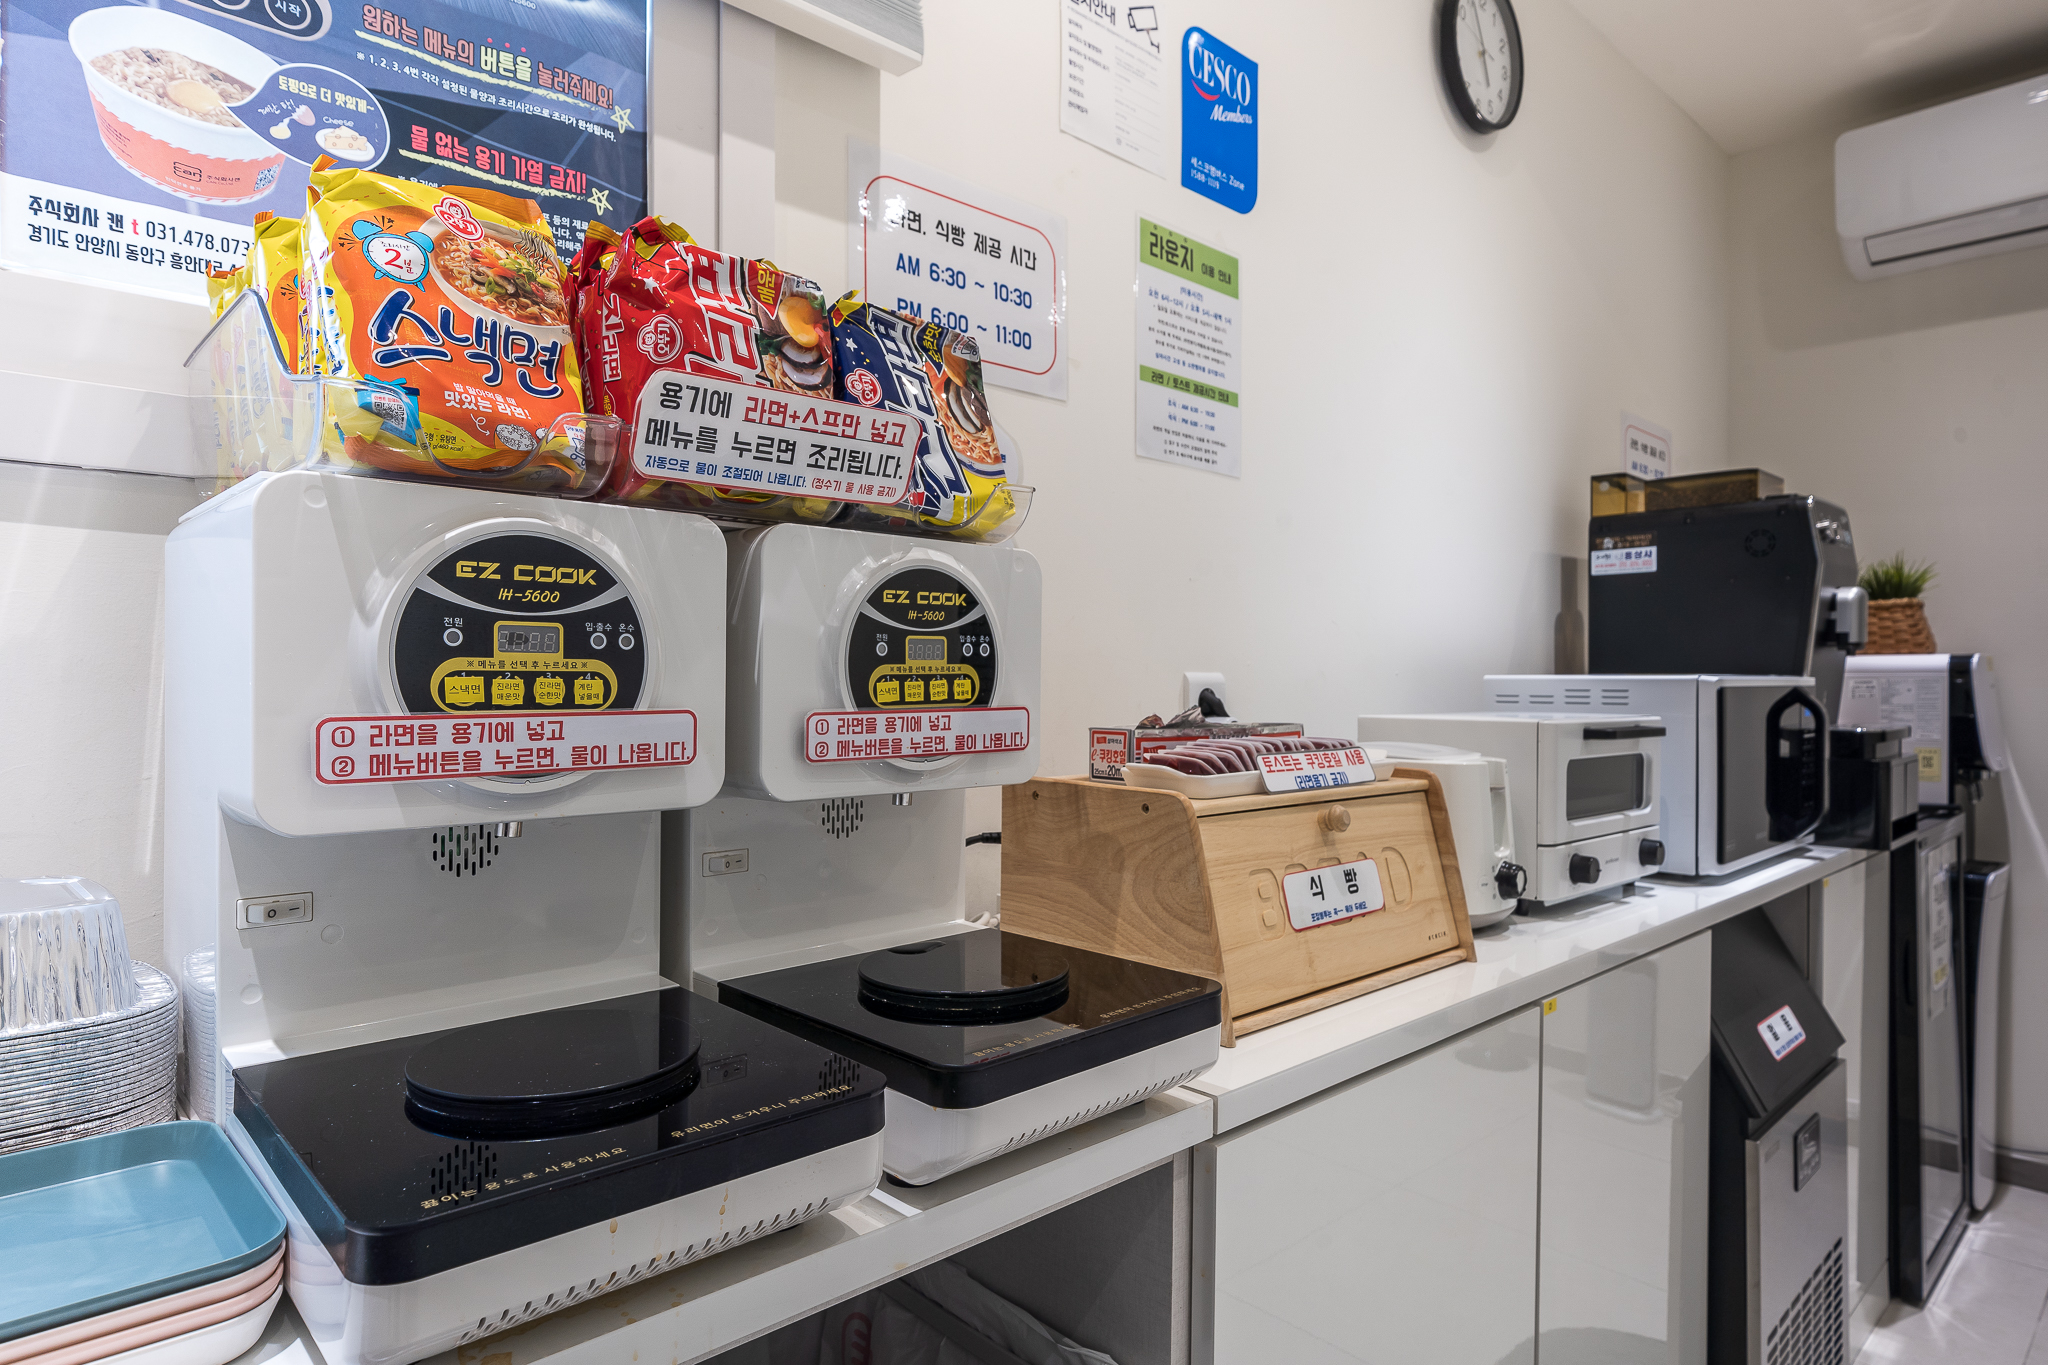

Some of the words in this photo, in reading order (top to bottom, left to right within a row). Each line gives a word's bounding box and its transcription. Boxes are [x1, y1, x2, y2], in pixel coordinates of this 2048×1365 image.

[275, 0, 301, 18] 시작
[362, 3, 418, 46] 원하는
[423, 26, 474, 67] 메뉴의
[480, 45, 532, 82] 버튼을
[537, 61, 614, 110] 눌러주세요!
[1188, 44, 1251, 106] CESCO
[278, 75, 317, 99] 토핑으로
[320, 87, 331, 103] 더
[403, 65, 419, 79] 4번
[421, 71, 439, 86] 각각
[441, 77, 467, 96] 설정된
[497, 95, 550, 118] 조리시간으로
[552, 109, 576, 126] 조리가
[322, 116, 355, 127] Cheese
[1210, 104, 1253, 124] Members
[411, 124, 428, 152] 물
[435, 130, 470, 164] 없는
[475, 145, 505, 176] 용기
[512, 155, 543, 186] 가열
[549, 165, 587, 194] 금지!
[28, 194, 99, 228] 주식회사
[106, 211, 125, 233] 캔
[131, 218, 139, 235] t
[146, 221, 255, 257] 031.478.073
[441, 211, 478, 236] 오뚜기
[27, 223, 69, 249] 경기도
[75, 233, 120, 258] 안양시
[125, 243, 165, 266] 동안구
[936, 218, 966, 247] 식빵
[973, 231, 1002, 259] 제공
[1010, 245, 1037, 271] 시간
[1149, 231, 1194, 272] 라운지
[896, 252, 921, 277] AM
[929, 262, 966, 290] 6:30
[993, 281, 1032, 309] 10:30
[656, 319, 671, 355] 오뚜기
[897, 297, 922, 319] PM
[930, 307, 969, 335] 6:00
[996, 324, 1032, 350] 11:00
[369, 287, 564, 399] 스낵면
[922, 322, 942, 363] 순한맛
[860, 375, 875, 400] 오뚜기
[444, 390, 493, 413] 맛있는
[496, 401, 532, 420] 라면!
[660, 381, 733, 419] 용기에
[744, 395, 861, 440] 라면+스프만
[870, 417, 907, 446] 넣고
[644, 418, 718, 454] 메뉴를
[731, 431, 797, 465] 누르면
[806, 442, 903, 479] 조리됩니다.
[644, 454, 690, 473] 자동으로
[695, 461, 717, 476] 물이
[721, 465, 763, 483] 조절되어
[767, 471, 807, 488] 나옵니다.
[811, 477, 841, 493] (정수기
[845, 481, 853, 493] 물
[857, 483, 874, 495] 사용
[877, 485, 896, 498] 금지)
[455, 560, 501, 580] EZ
[513, 564, 597, 586] COOK
[498, 588, 560, 603] IH-5600
[883, 589, 910, 604] EZ
[916, 591, 967, 607] COOK
[443, 617, 463, 627] 전원
[618, 623, 635, 633] 온수
[907, 610, 945, 621] IH-5600
[478, 660, 506, 669] 메뉴를
[510, 660, 528, 669] 선택
[531, 660, 539, 669] 후
[543, 661, 578, 669] 누르세요
[449, 684, 480, 695] 스낵면
[496, 682, 520, 690] 진라면
[496, 692, 520, 701] 매운맛
[538, 681, 561, 689] 진라면
[538, 691, 562, 700] 순한맛
[578, 682, 593, 691] 계란
[578, 692, 600, 700] 넣을때
[878, 687, 897, 696] 스낵면
[369, 723, 439, 747] 라면을
[451, 721, 515, 744] 용기에
[526, 720, 565, 742] 넣고
[837, 717, 877, 735] 라면을
[884, 715, 922, 733] 용기에
[928, 715, 951, 732] 넣고
[836, 738, 903, 758] 메뉴버튼을
[954, 734, 977, 751] 물이
[983, 731, 1026, 749] 나옵니다.
[369, 750, 483, 776] 메뉴버튼을
[570, 745, 607, 766] 물이
[618, 741, 691, 764] 나옵니다.
[1261, 755, 1304, 773] 토스트는
[1304, 751, 1343, 770] 쿠킹호일
[1344, 749, 1365, 766] 사용
[670, 1117, 730, 1138] 유리면이
[731, 1101, 787, 1122] 뜨거우니
[788, 1083, 853, 1105] 주의하세요
[419, 1188, 479, 1211] 끓이는
[484, 1170, 538, 1190] 용도로
[544, 1146, 628, 1174] 사용하세요
